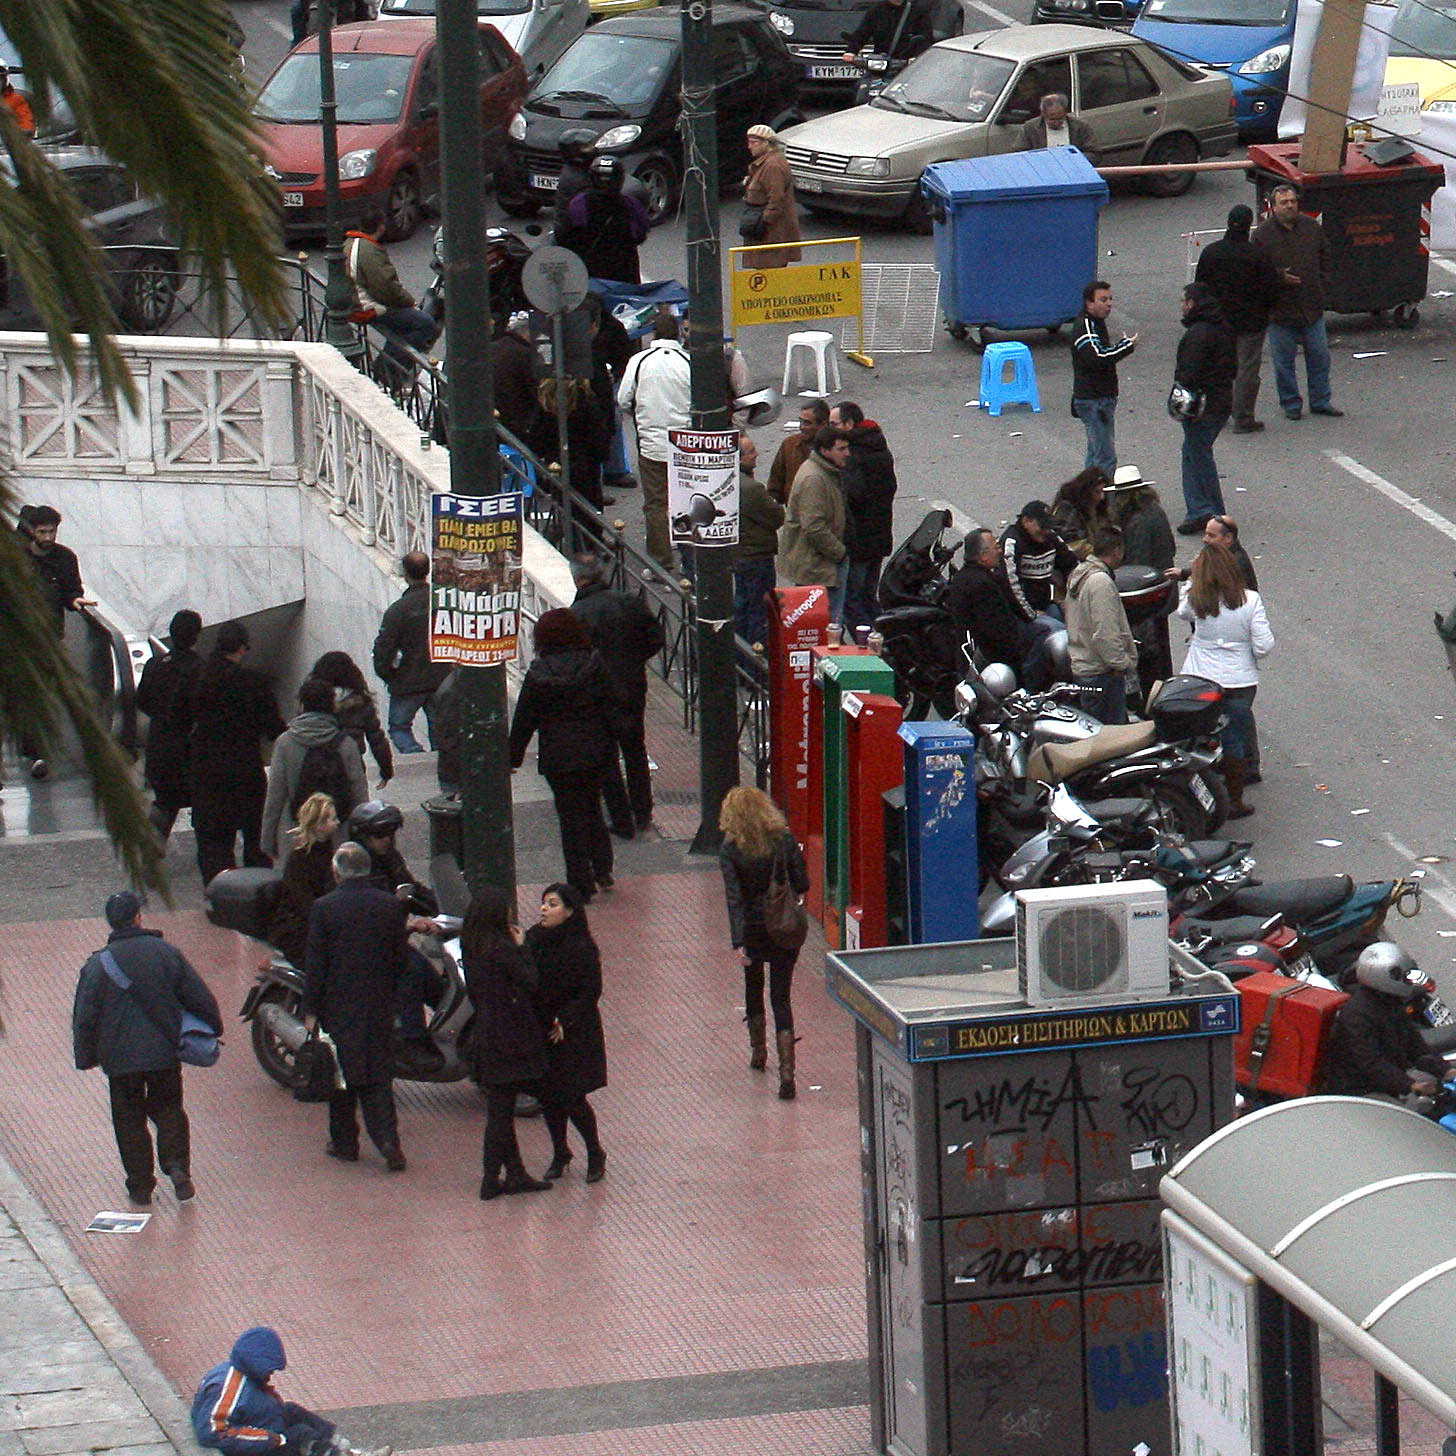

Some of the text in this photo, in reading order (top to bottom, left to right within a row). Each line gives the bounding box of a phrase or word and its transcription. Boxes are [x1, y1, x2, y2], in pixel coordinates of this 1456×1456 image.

[741, 292, 843, 309] ΥΠΟΥΡΓΕΙΟ ΟΙΚΟΝΟΜΙΑΣ
[772, 304, 836, 319] ΟΙΚΟΝΟΜΙΚΩΝ
[676, 435, 733, 449] ΑΠΕΡΓΟΥΜΕ
[696, 453, 706, 464] 11
[440, 496, 516, 516] ΓΣΕΕ
[501, 520, 518, 533] ΘΑ
[434, 587, 457, 608] 11
[783, 587, 825, 629] Metropolis
[433, 609, 517, 640] ΑΠΕΡΓΙΑ
[958, 1009, 1190, 1049] ΕΚΔΟΣΗ ΕΙΣΙΤΗΡΙΩΝ & ΚΑΡΤΩΝ
